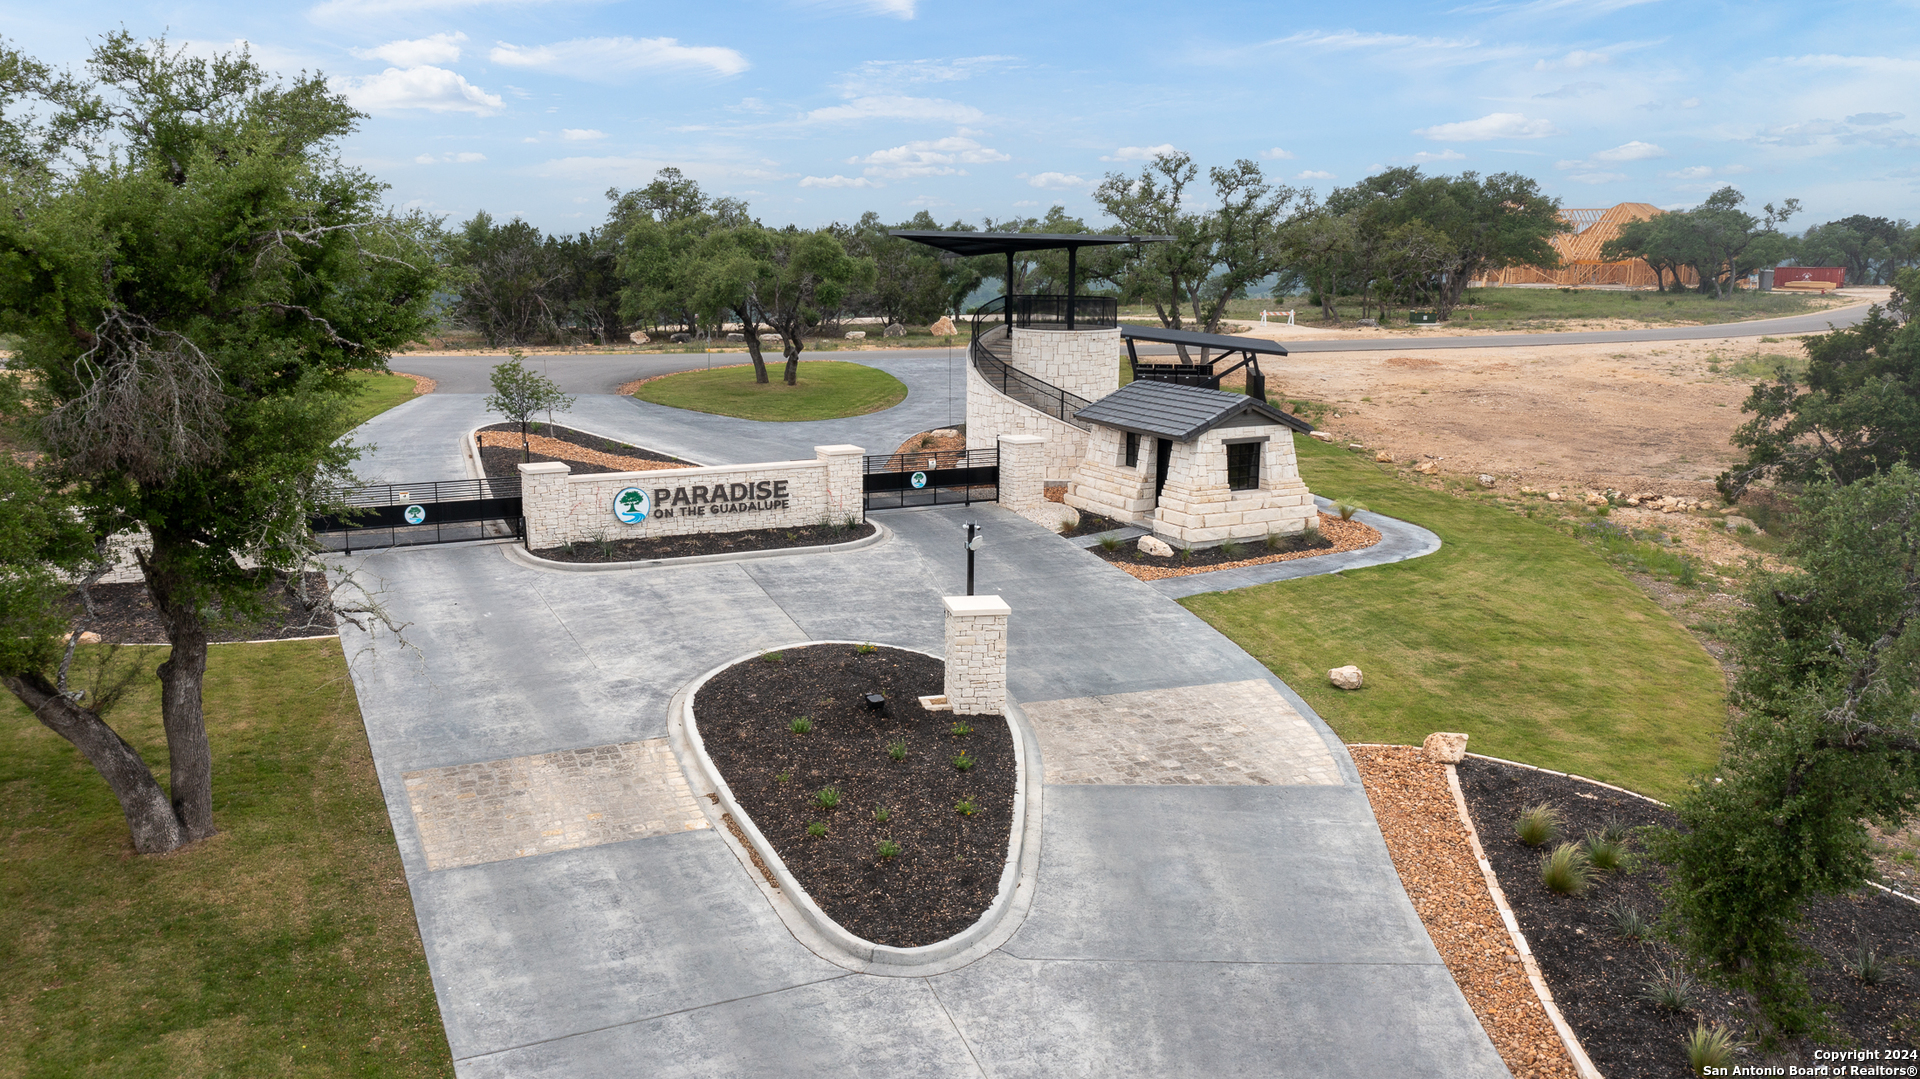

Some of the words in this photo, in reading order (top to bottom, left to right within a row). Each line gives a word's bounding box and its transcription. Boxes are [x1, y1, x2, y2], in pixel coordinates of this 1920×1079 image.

[654, 480, 790, 507] PARADISE
[654, 508, 674, 519] ON
[680, 506, 706, 517] THE
[710, 500, 790, 514] GUADALUPE
